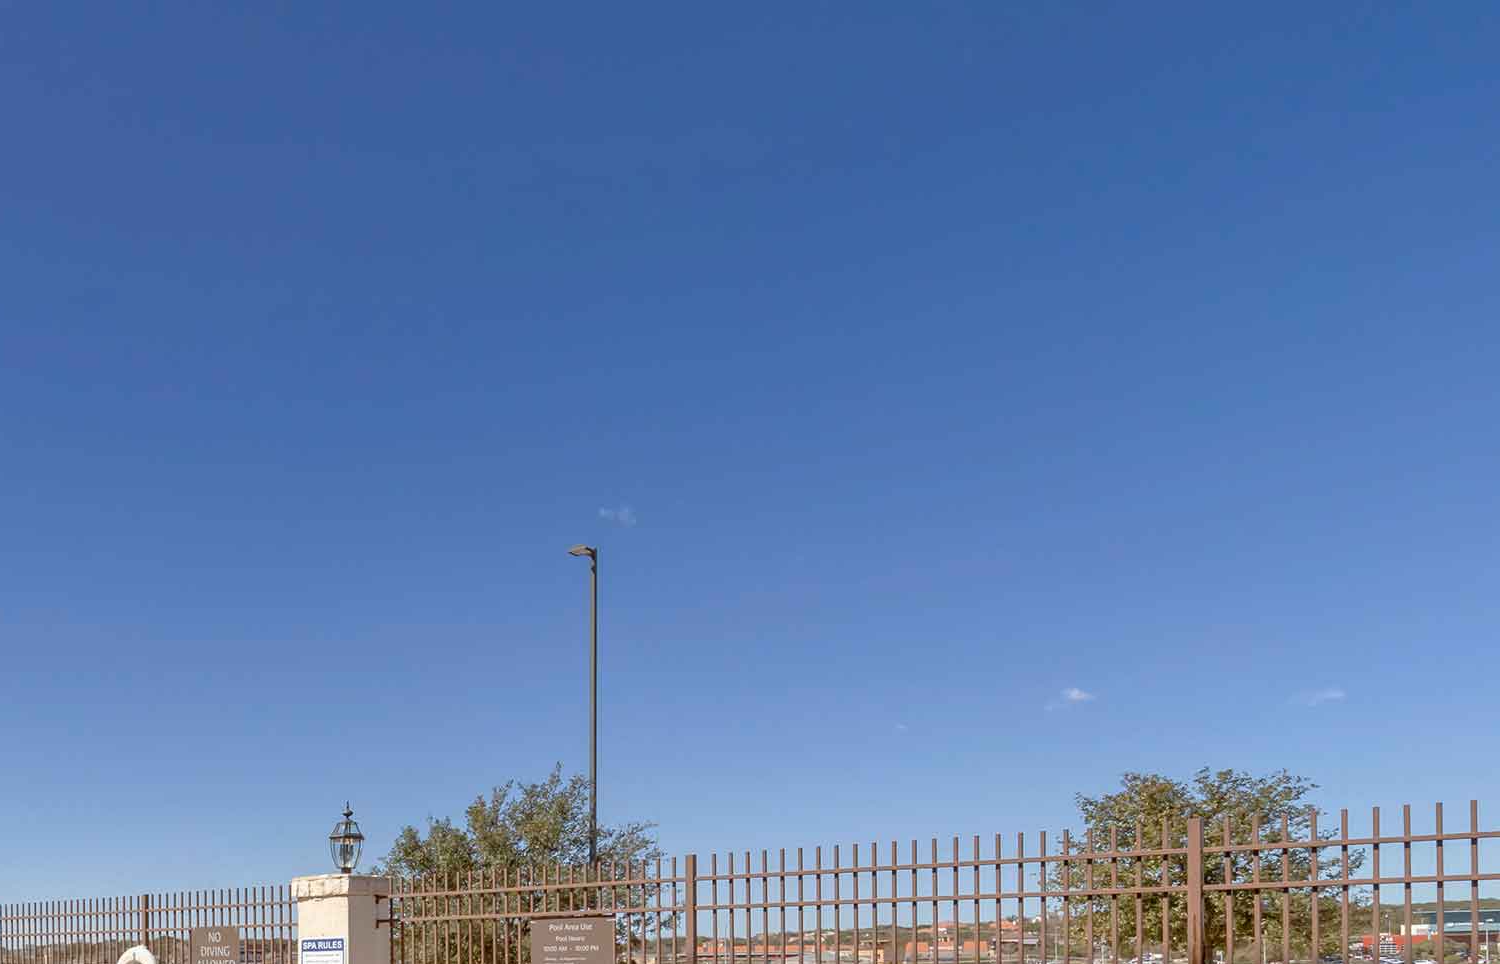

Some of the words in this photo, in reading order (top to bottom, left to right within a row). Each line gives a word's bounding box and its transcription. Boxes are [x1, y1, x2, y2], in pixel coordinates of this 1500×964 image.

[208, 931, 221, 943] NO
[303, 942, 317, 950] SPA
[318, 940, 342, 949] RULES
[201, 946, 230, 957] DIVING
